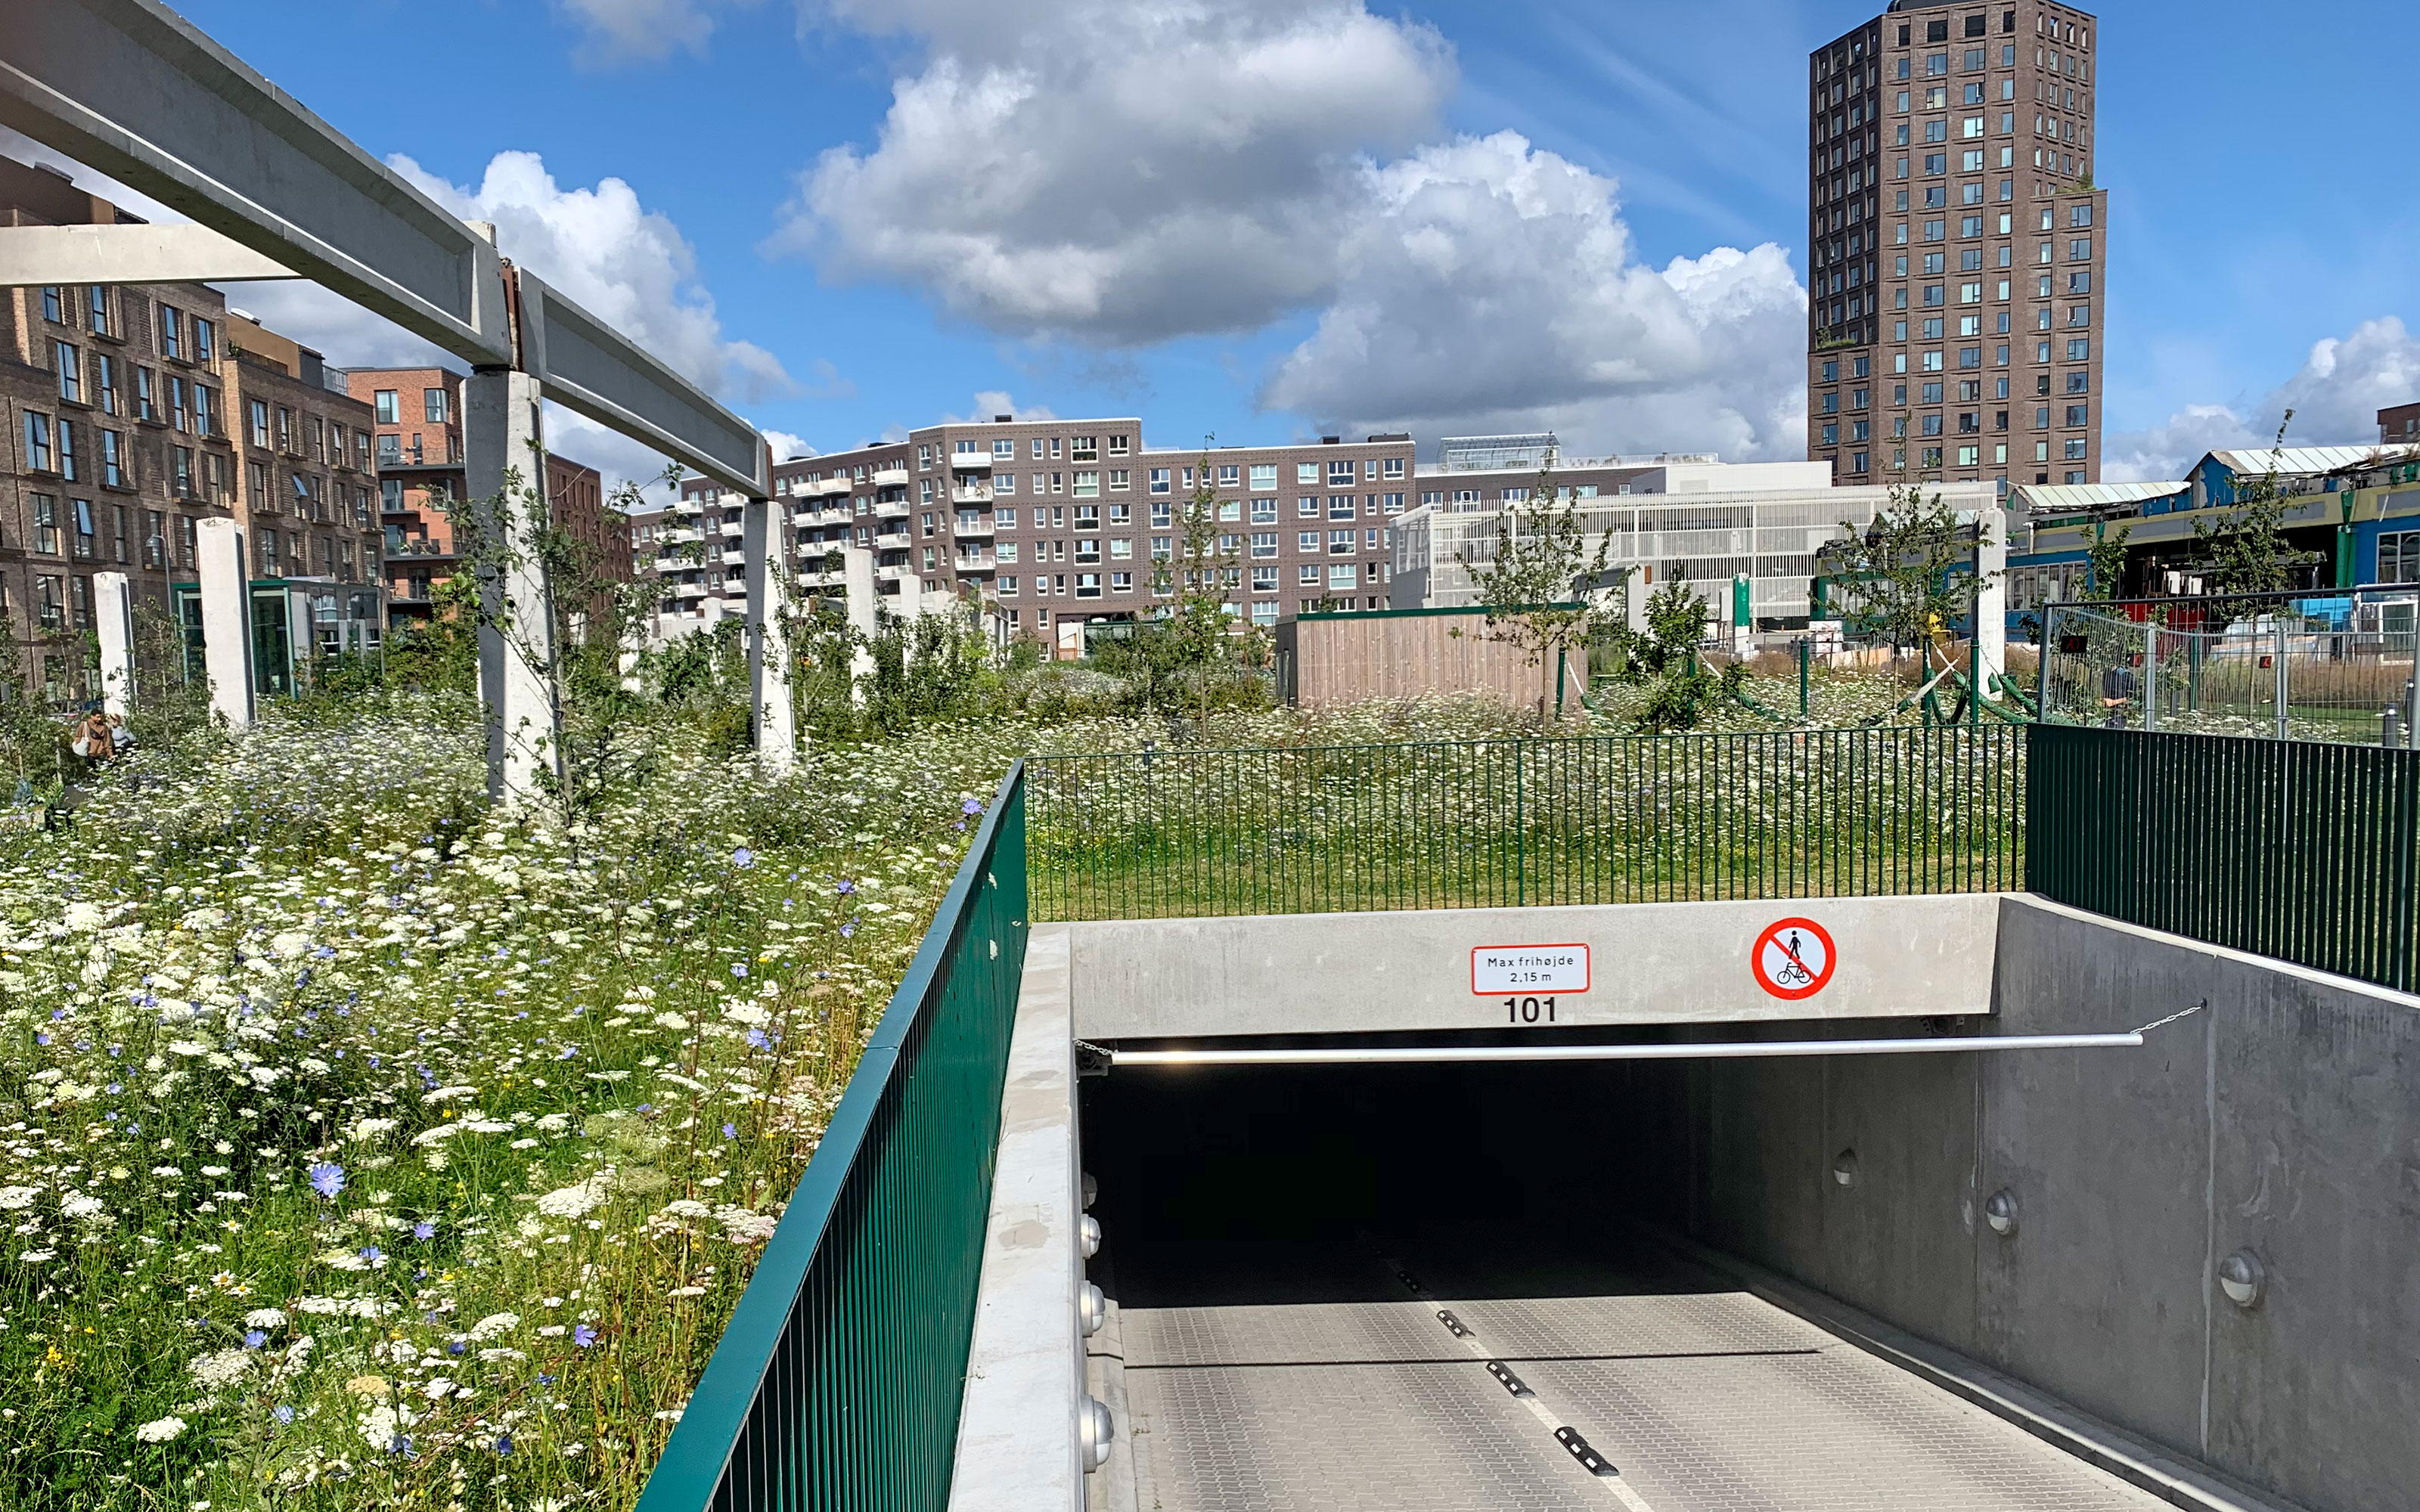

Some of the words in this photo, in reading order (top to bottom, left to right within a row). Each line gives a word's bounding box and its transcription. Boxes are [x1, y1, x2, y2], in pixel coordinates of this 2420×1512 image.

[1488, 958, 1515, 967] Max
[1519, 956, 1574, 967] frihøjde
[1503, 996, 1555, 1023] 101
